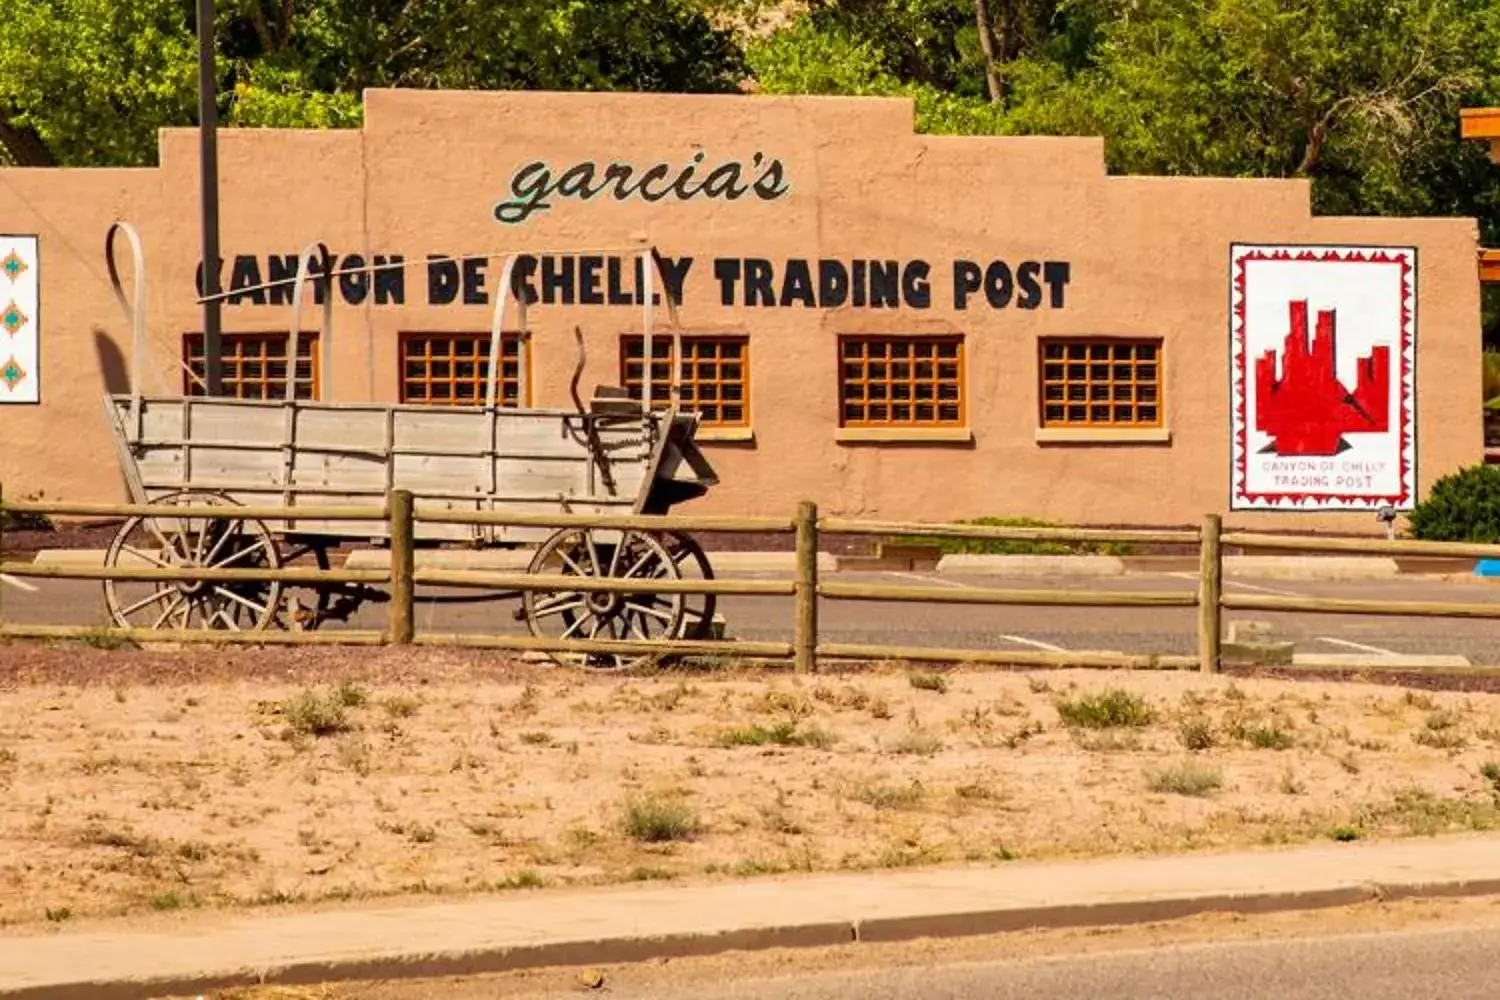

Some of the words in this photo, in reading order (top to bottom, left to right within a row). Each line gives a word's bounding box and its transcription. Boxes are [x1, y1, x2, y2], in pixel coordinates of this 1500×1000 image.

[494, 151, 789, 224] garcia's
[427, 255, 488, 305] DE
[510, 254, 693, 306] CHELLY
[714, 258, 931, 308] TRADING
[953, 260, 1070, 310] POST
[1274, 475, 1330, 488] TRADING
[1335, 475, 1374, 489] POST
